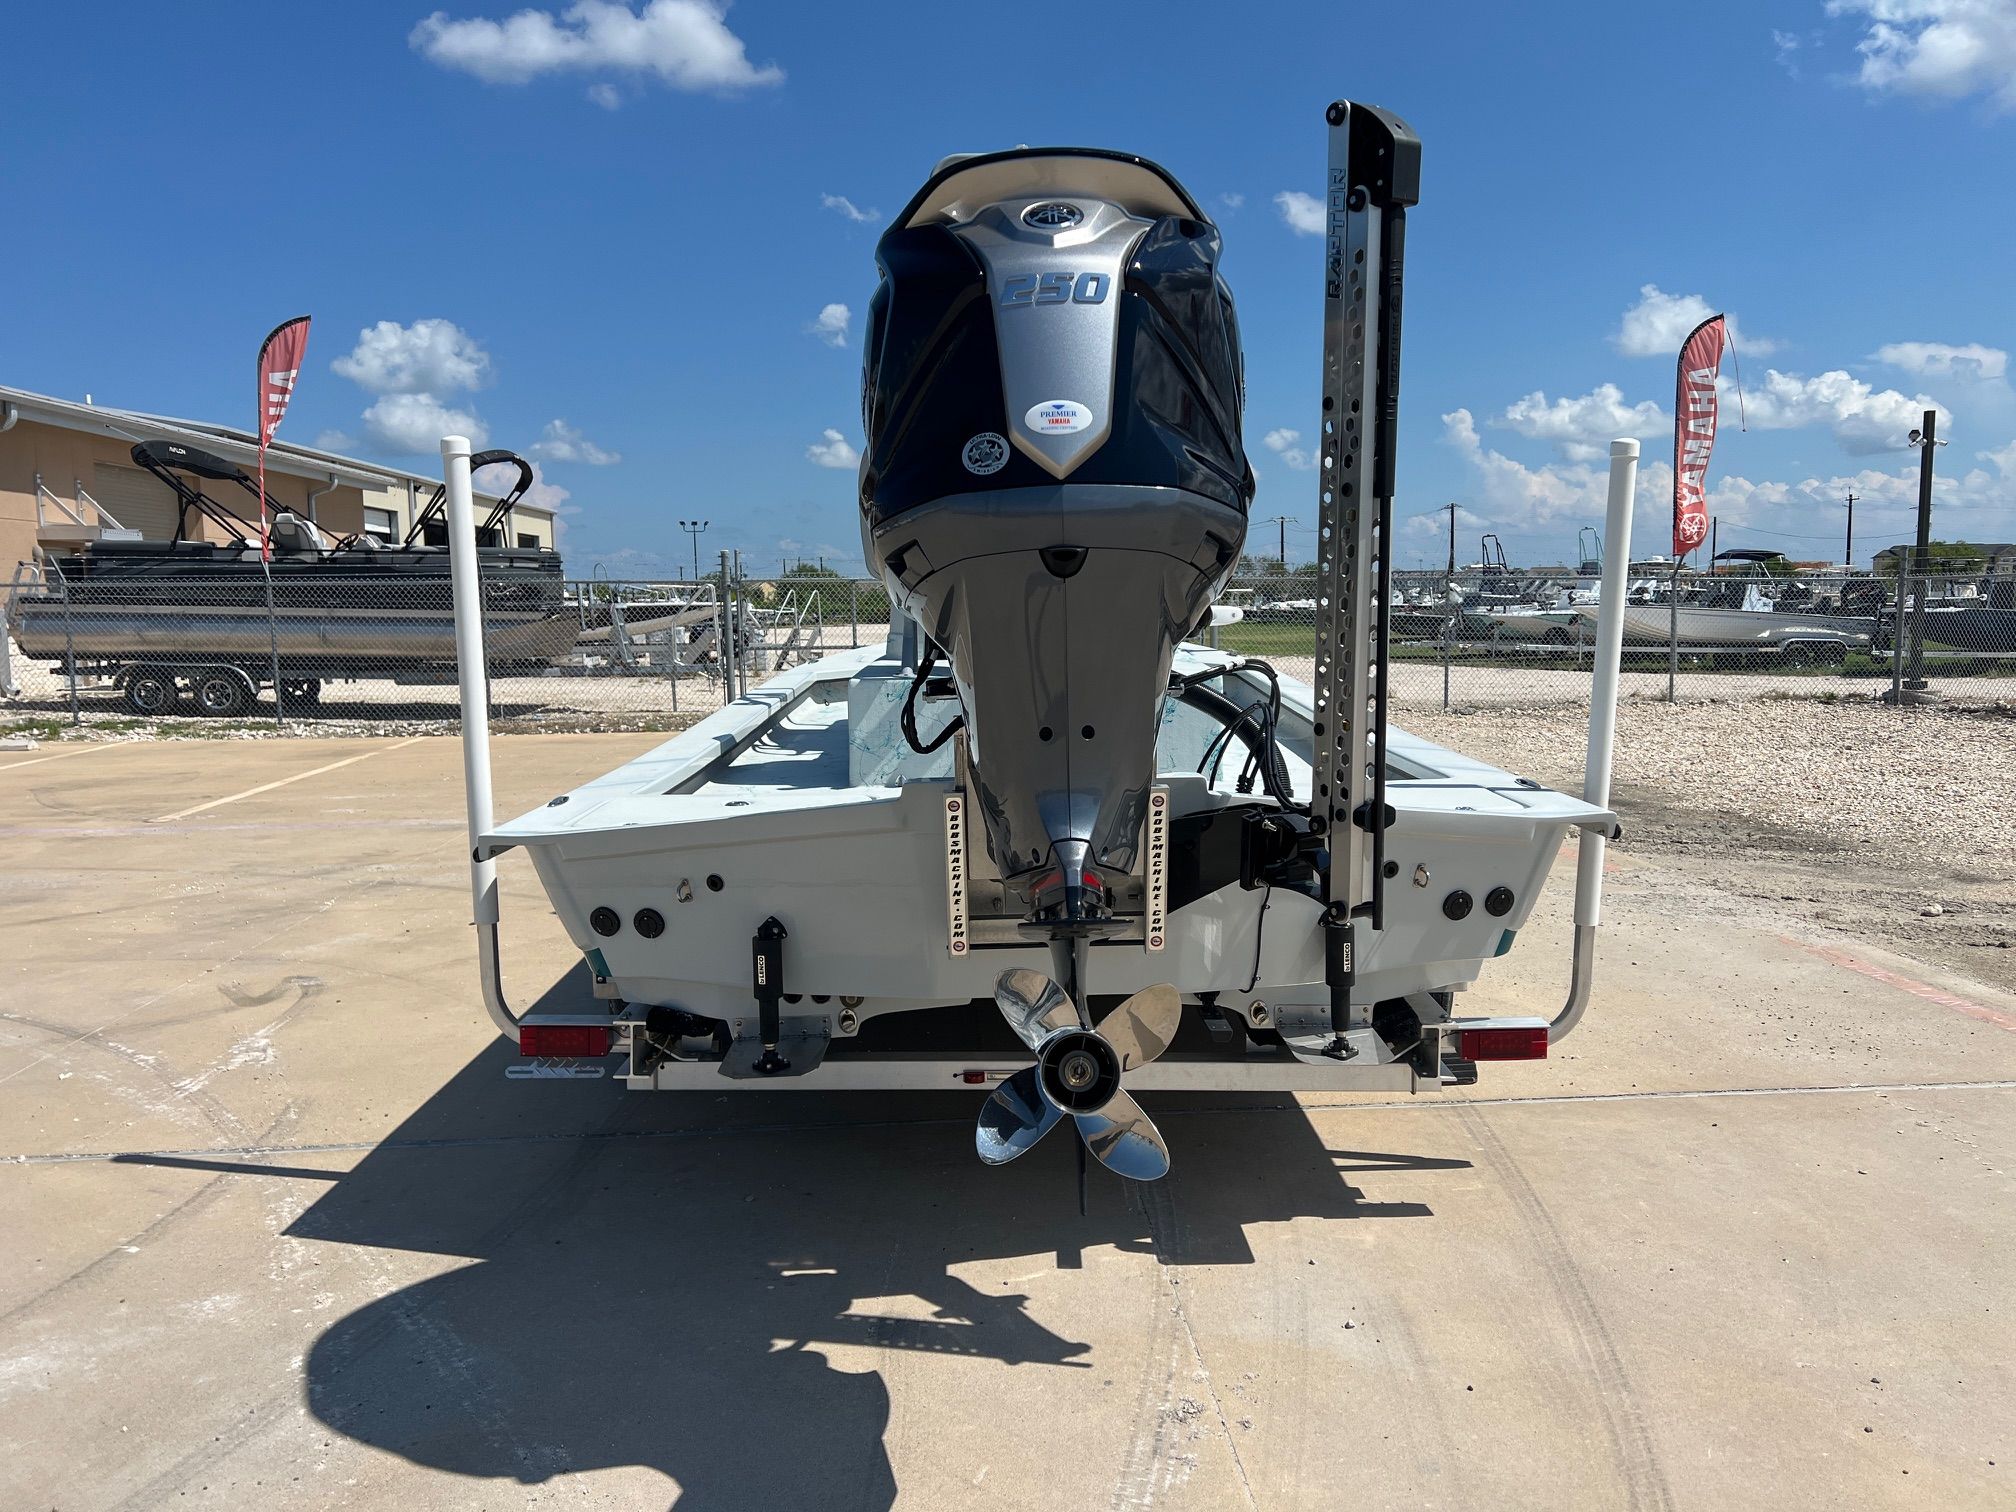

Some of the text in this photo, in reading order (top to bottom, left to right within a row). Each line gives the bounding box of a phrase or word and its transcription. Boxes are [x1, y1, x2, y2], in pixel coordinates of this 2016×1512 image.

[1328, 168, 1345, 300] RAPTOR
[1001, 272, 1111, 305] 250
[1040, 410, 1078, 418] PREMIER
[1681, 366, 1717, 507] YAMAHA
